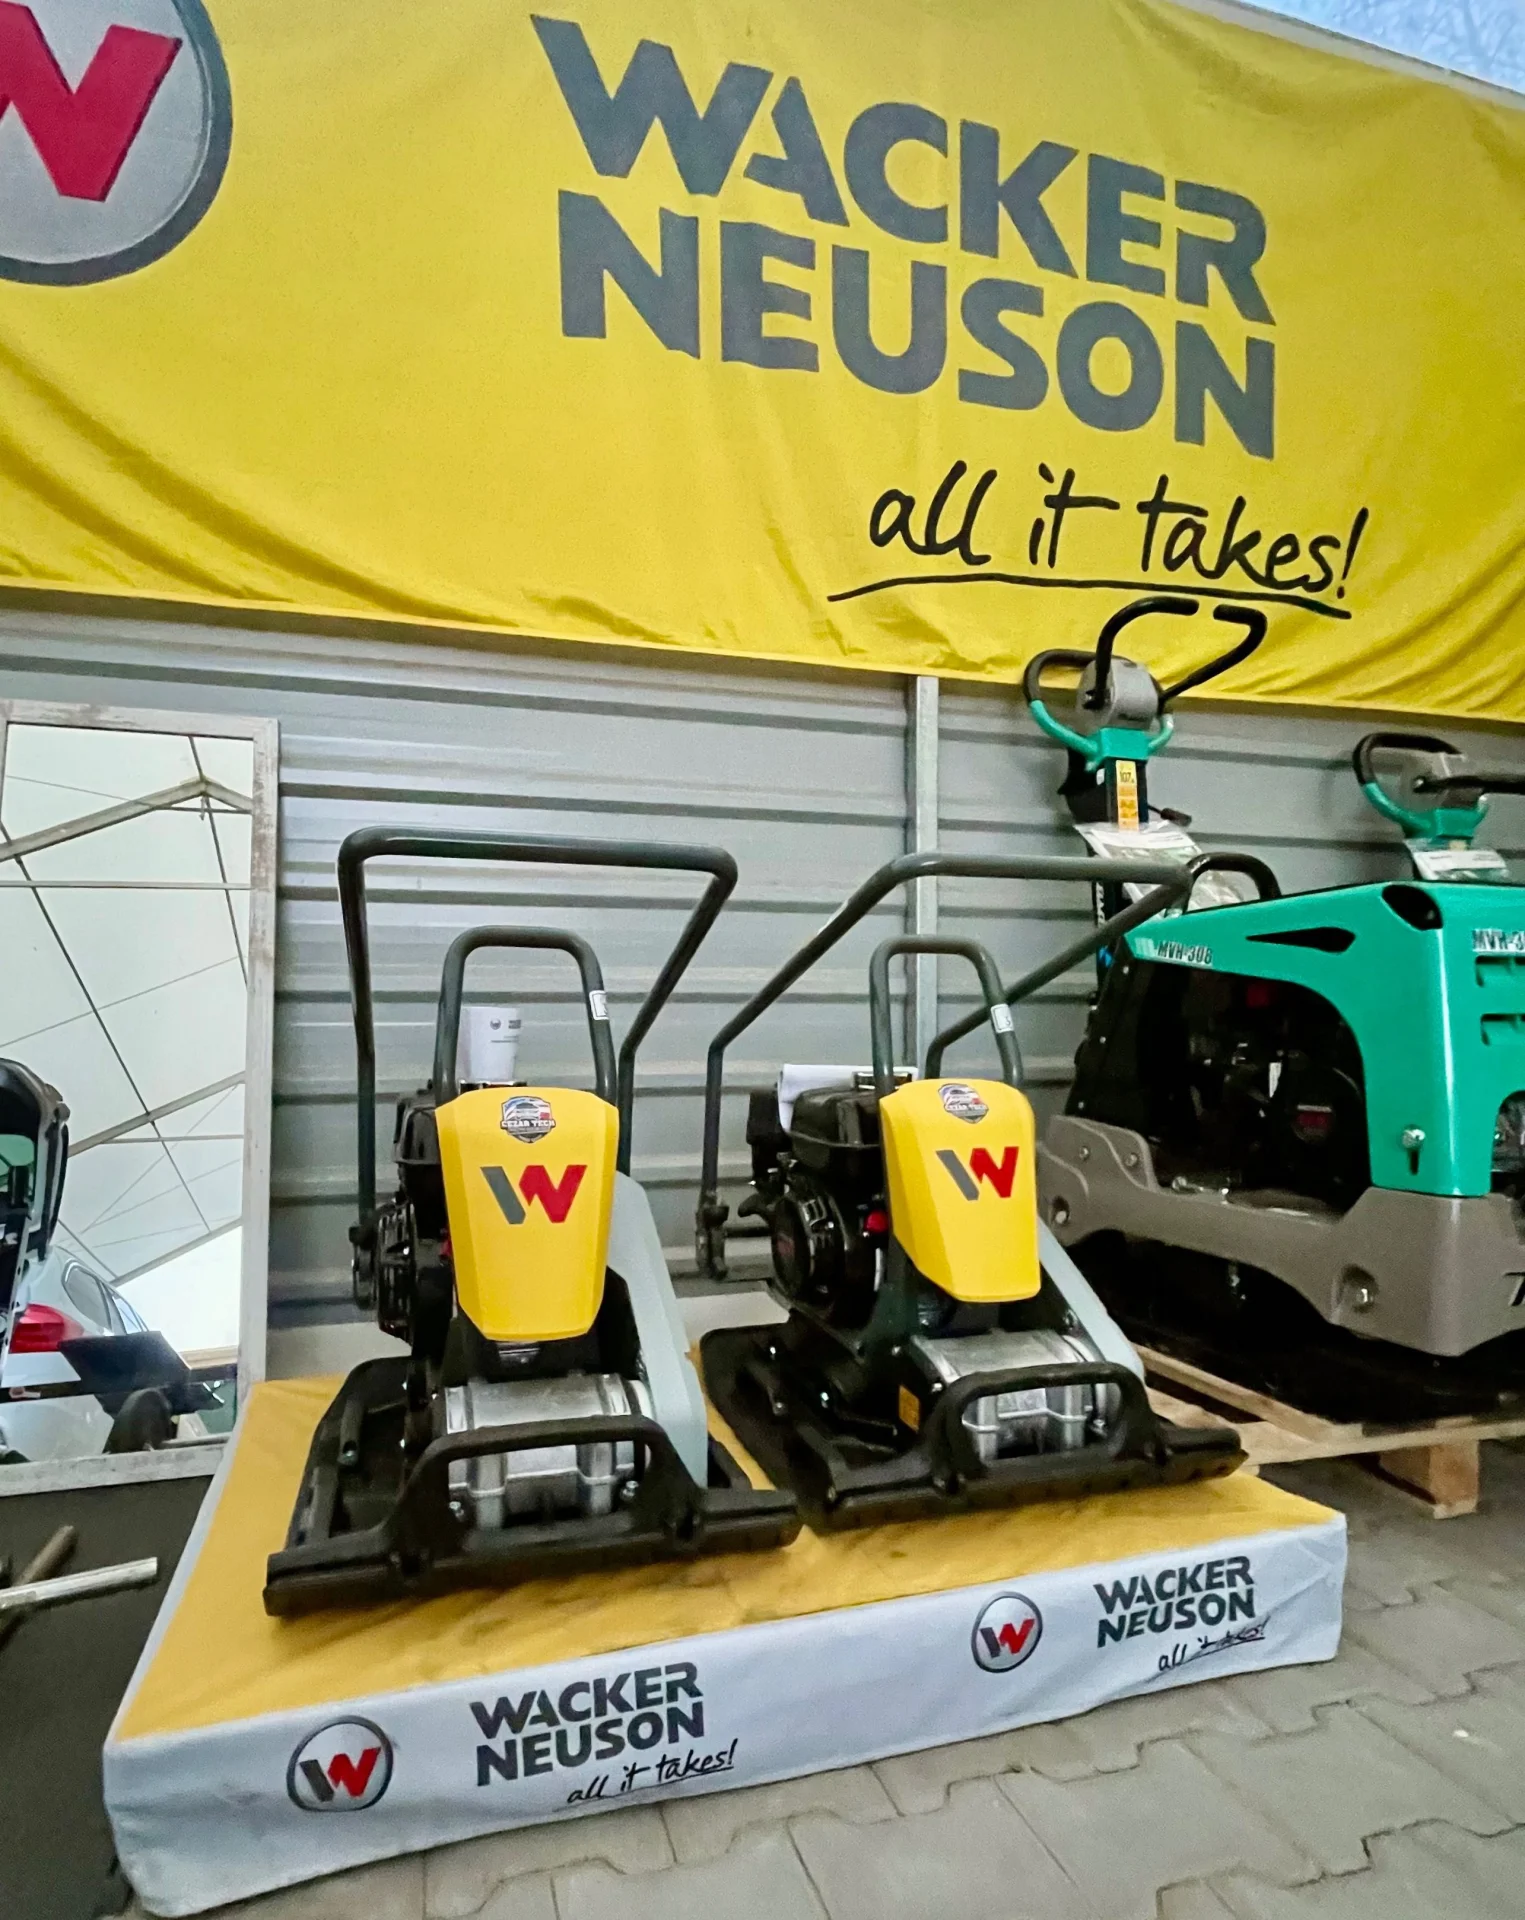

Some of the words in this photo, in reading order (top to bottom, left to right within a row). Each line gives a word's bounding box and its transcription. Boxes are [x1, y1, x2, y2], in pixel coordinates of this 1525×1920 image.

[530, 14, 1277, 327] WACKER
[558, 188, 1276, 461] NEUSON
[869, 460, 998, 566] all
[1029, 462, 1121, 568] it
[1136, 474, 1369, 599] takes!
[1093, 1555, 1254, 1614] WACKER
[1097, 1588, 1255, 1648] NEUSON
[1158, 1643, 1188, 1671] all
[469, 1662, 704, 1739] WACKER
[476, 1701, 704, 1787] NEUSON
[567, 1774, 609, 1803] all
[620, 1762, 651, 1792] it
[656, 1738, 739, 1783] takes!
